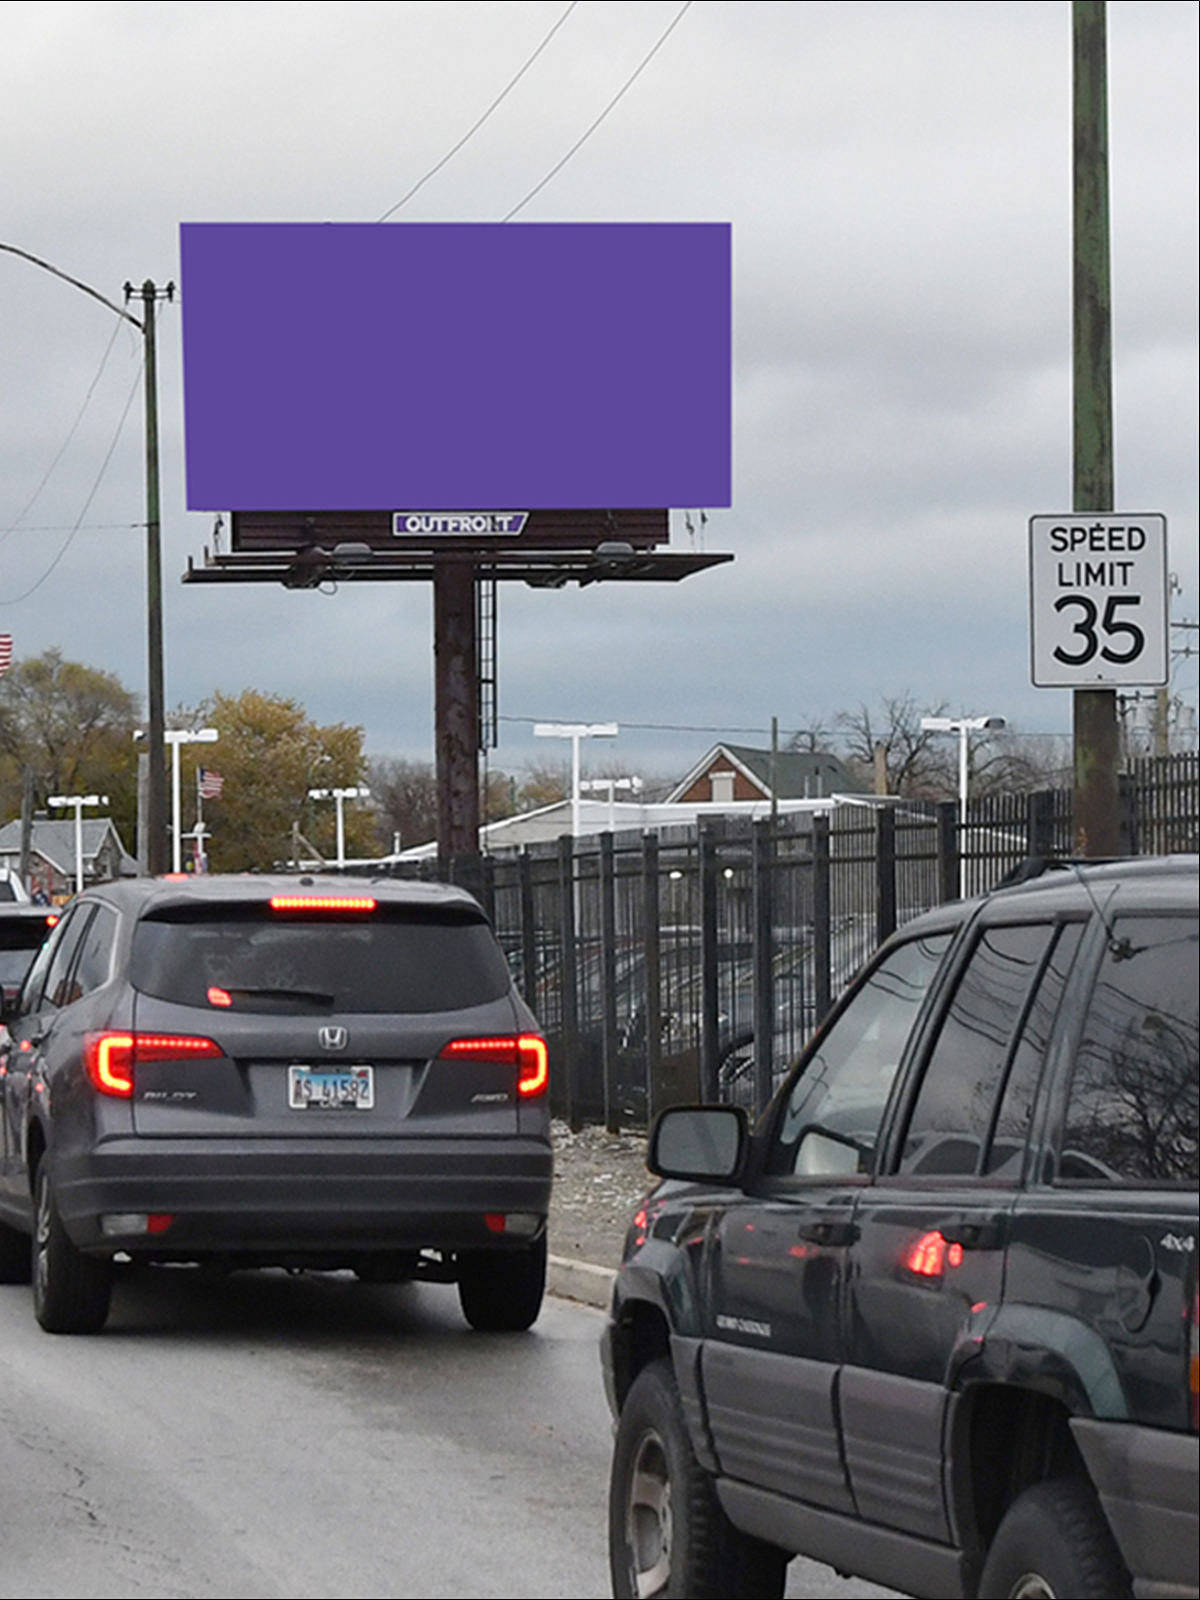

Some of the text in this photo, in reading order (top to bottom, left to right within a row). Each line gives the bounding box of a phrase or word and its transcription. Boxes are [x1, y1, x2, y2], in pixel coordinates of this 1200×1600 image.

[1050, 526, 1146, 552] SPEED
[1058, 561, 1135, 587] LIMIT
[1053, 594, 1145, 666] 35
